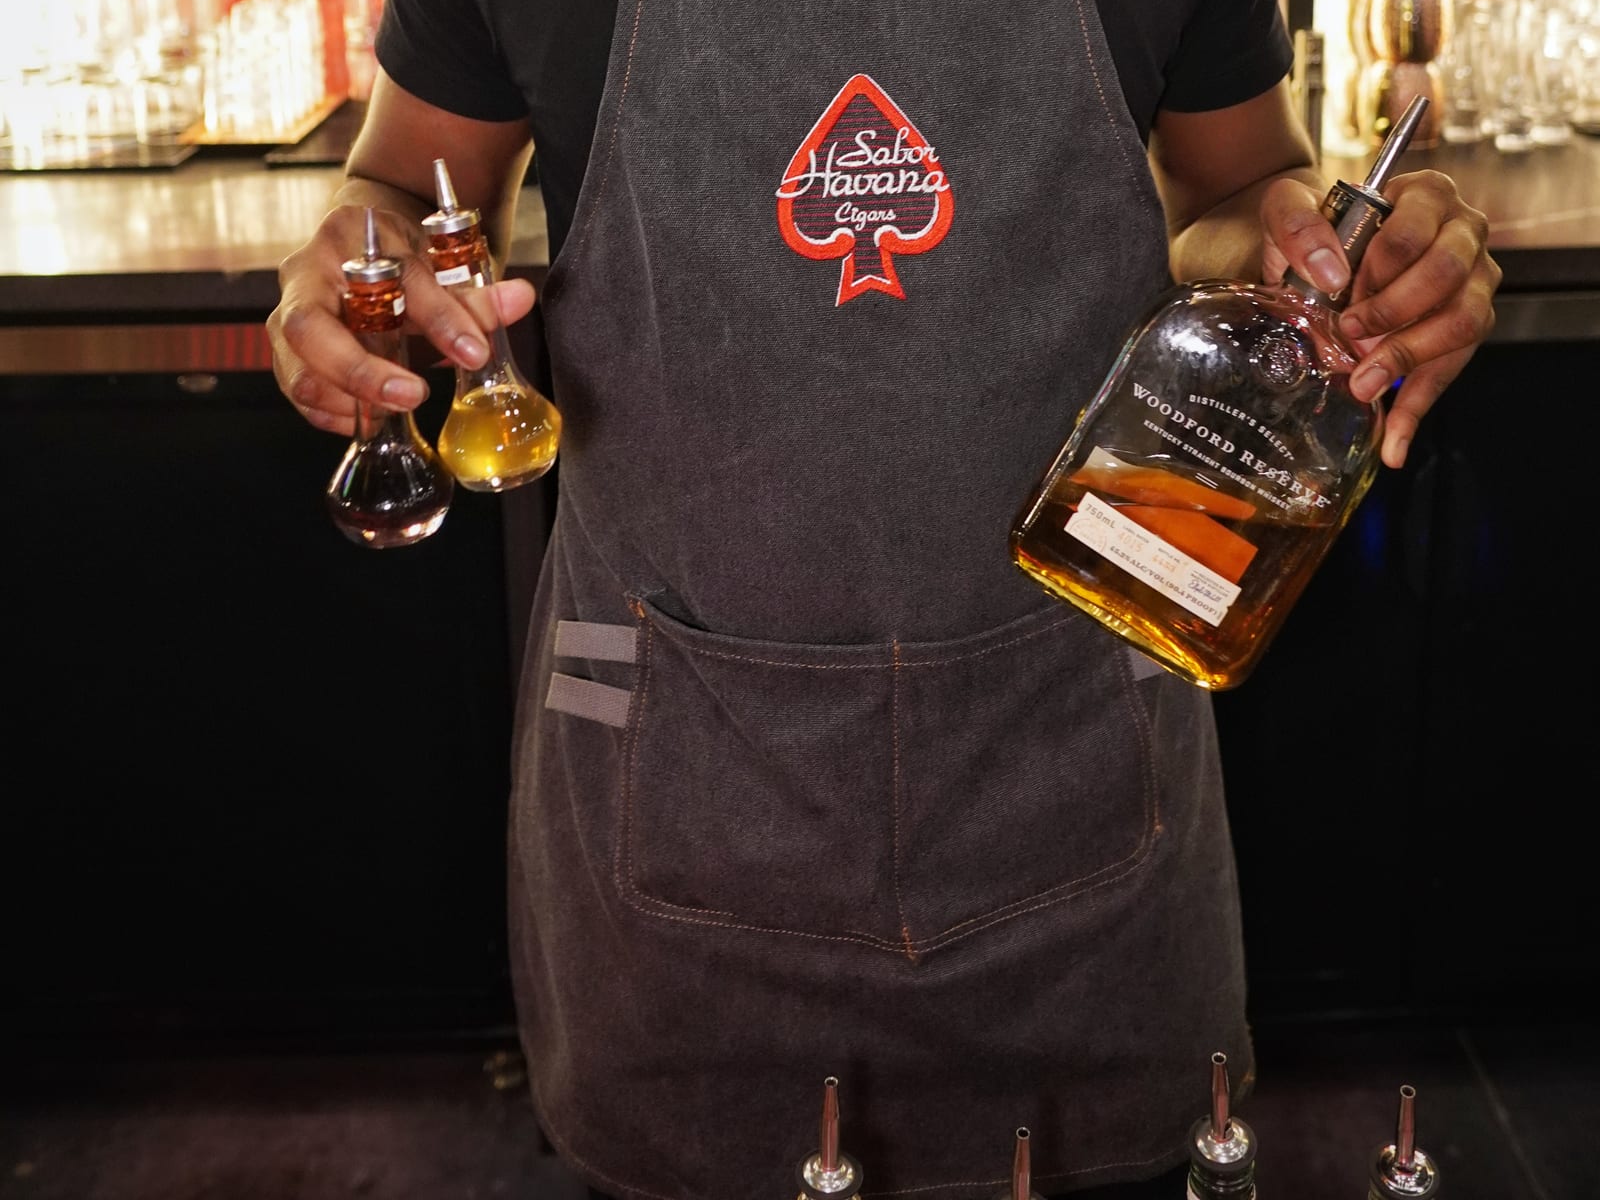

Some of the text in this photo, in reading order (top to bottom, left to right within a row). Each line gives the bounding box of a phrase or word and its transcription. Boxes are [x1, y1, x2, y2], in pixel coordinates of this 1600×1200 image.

[836, 126, 940, 167] Sabor
[775, 141, 950, 198] Havana
[835, 201, 897, 231] Cigars
[1188, 393, 1257, 427] DISTILLER'S
[1132, 382, 1330, 509] WOODFORD RESERVE
[1143, 418, 1183, 447] KENTUCKY
[1182, 443, 1221, 469] STRAIGHT
[1220, 466, 1257, 491] BOURBON
[1085, 503, 1116, 529] 750mL
